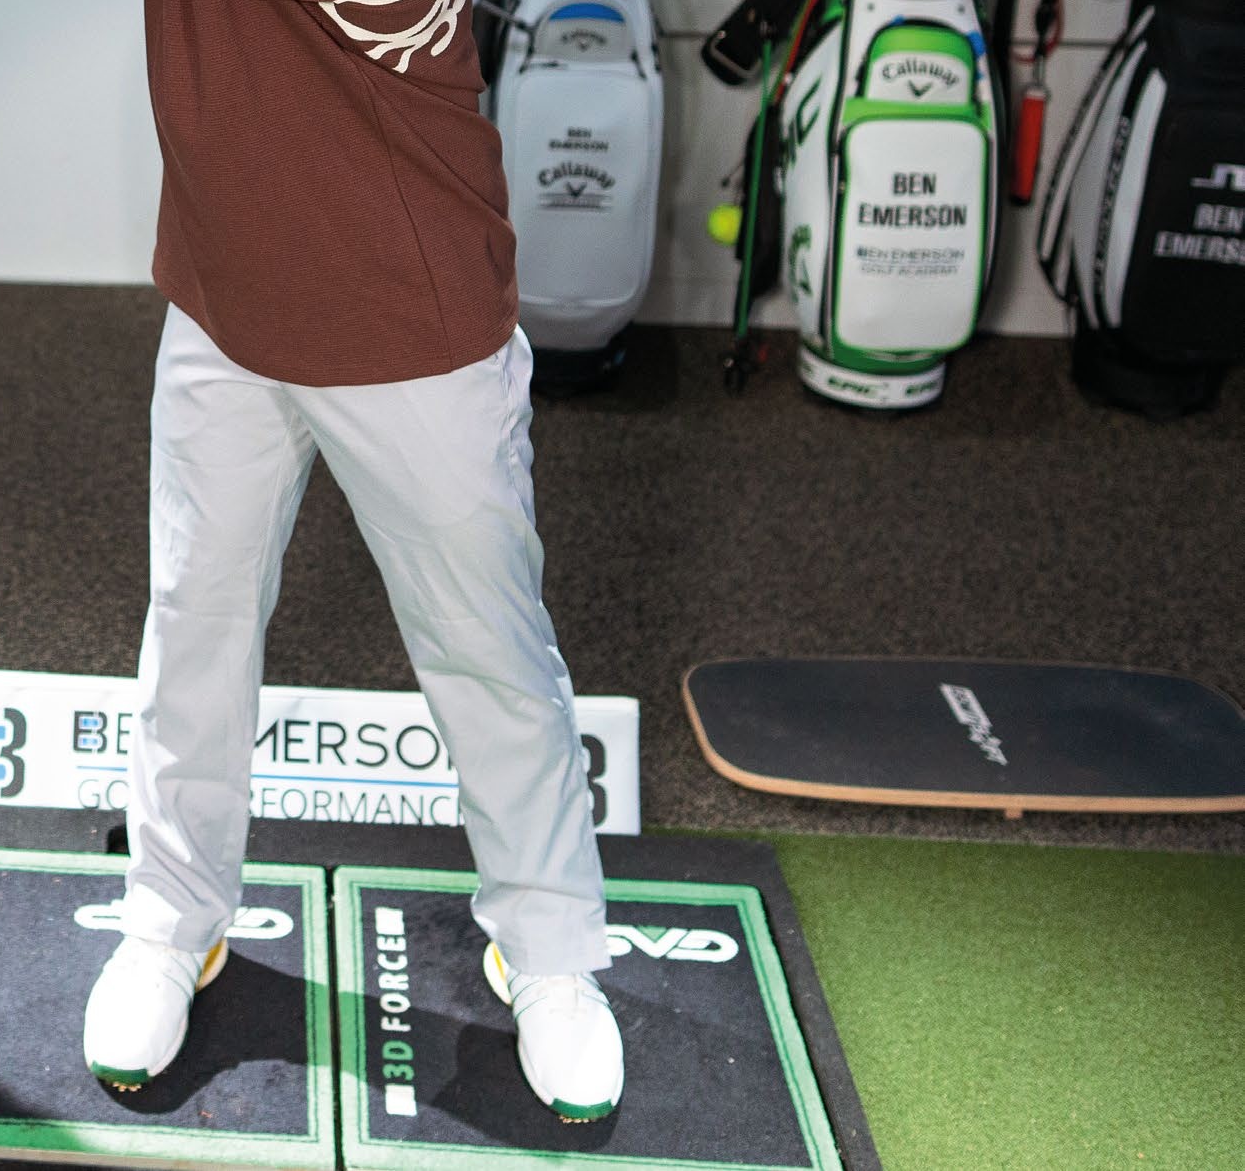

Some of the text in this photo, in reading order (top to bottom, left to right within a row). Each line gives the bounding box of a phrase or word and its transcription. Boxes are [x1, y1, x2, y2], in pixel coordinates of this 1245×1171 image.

[882, 57, 959, 87] Callaway
[892, 173, 936, 196] BEN
[858, 203, 967, 228] EMERSON
[376, 935, 412, 1033] FORCE
